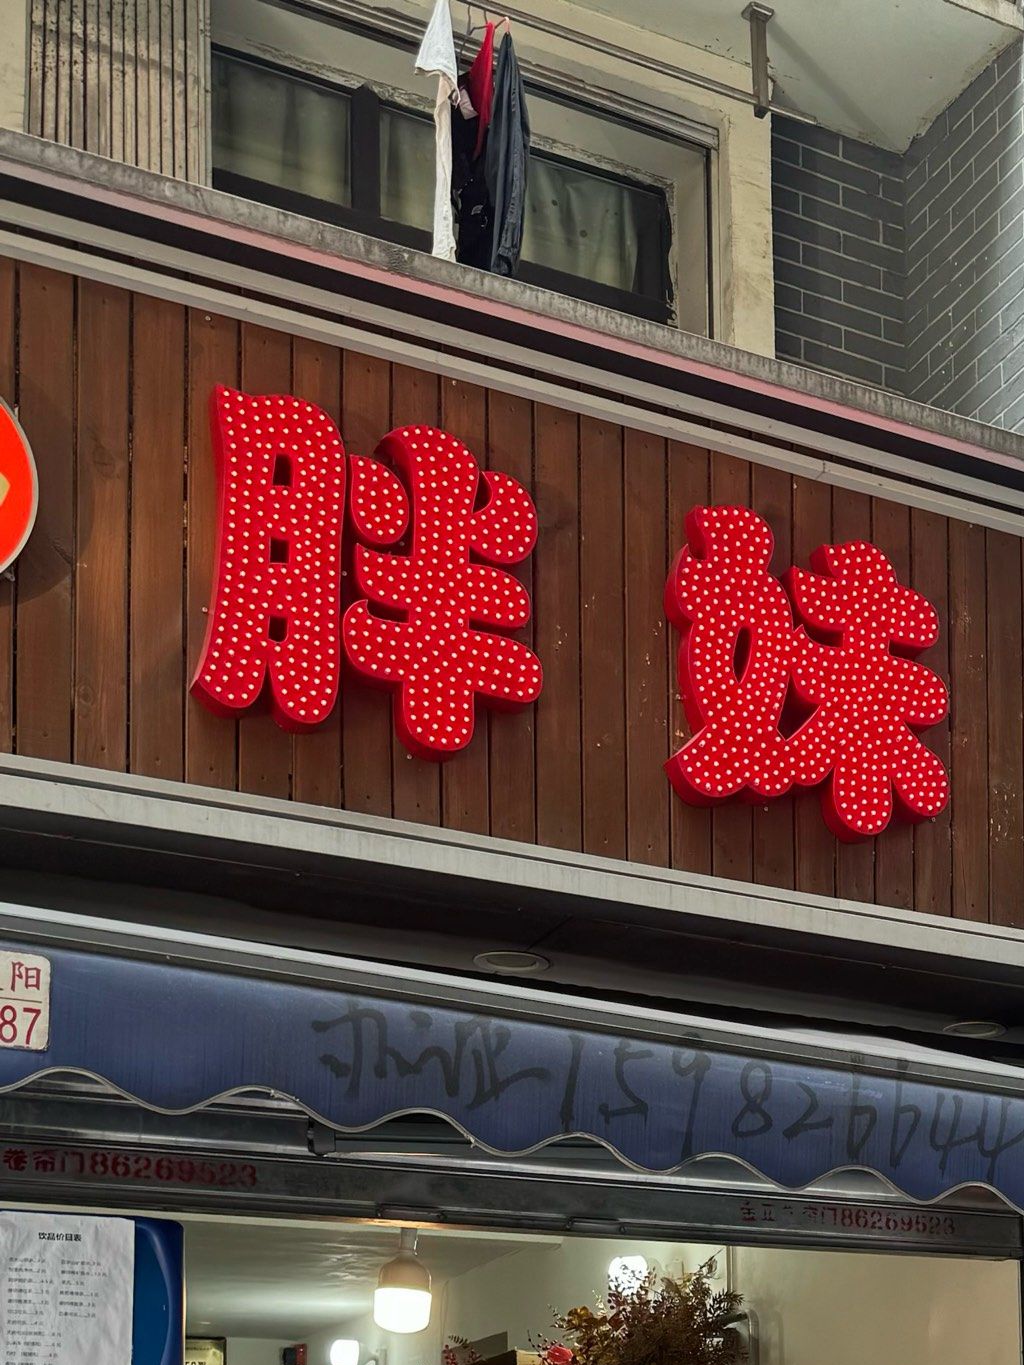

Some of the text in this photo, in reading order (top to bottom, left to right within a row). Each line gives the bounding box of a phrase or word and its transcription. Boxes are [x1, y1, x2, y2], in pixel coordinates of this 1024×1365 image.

[11, 961, 41, 992] 阳
[38, 1231, 82, 1242] 饮品价目表
